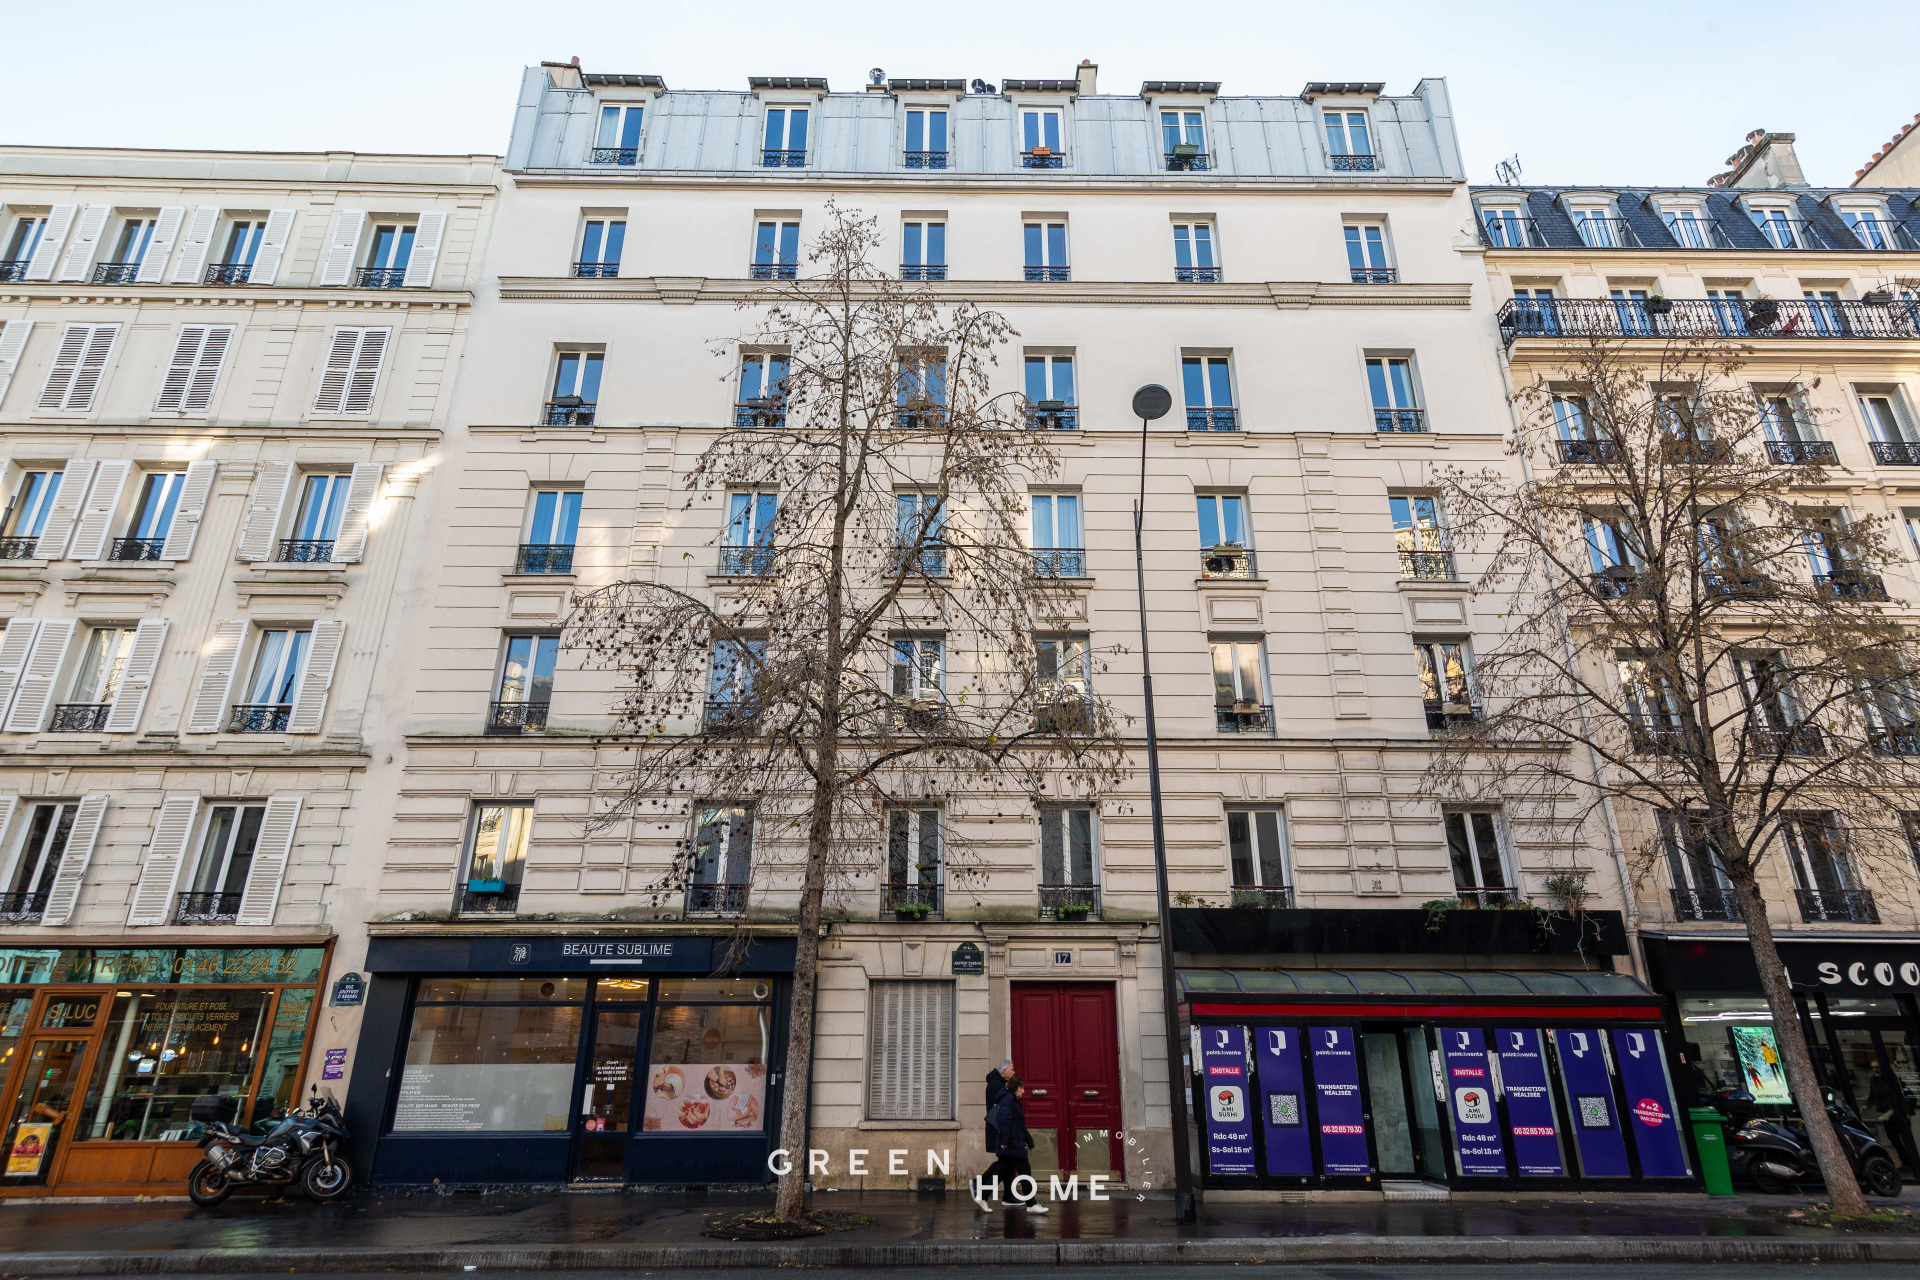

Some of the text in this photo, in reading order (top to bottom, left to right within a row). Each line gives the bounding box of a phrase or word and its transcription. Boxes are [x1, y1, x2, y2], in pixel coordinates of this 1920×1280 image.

[563, 944, 672, 955] BEAUTE SUBLIME
[1058, 953, 1069, 964] 17
[173, 957, 193, 974] 01
[197, 957, 220, 974] 46
[223, 957, 244, 974] 22
[249, 957, 270, 974] 24
[275, 957, 297, 974] 32
[1817, 961, 1920, 986] SCOO
[66, 1004, 97, 1019] LUC
[155, 1002, 228, 1011] FOURNITURE ET POSE
[151, 1012, 169, 1021] TOUS
[206, 1012, 239, 1021] VERRIERS
[172, 1023, 228, 1031] REMPLACEMENT
[1652, 1103, 1659, 1112] 2
[1633, 1109, 1670, 1119] TRANSACTIONS
